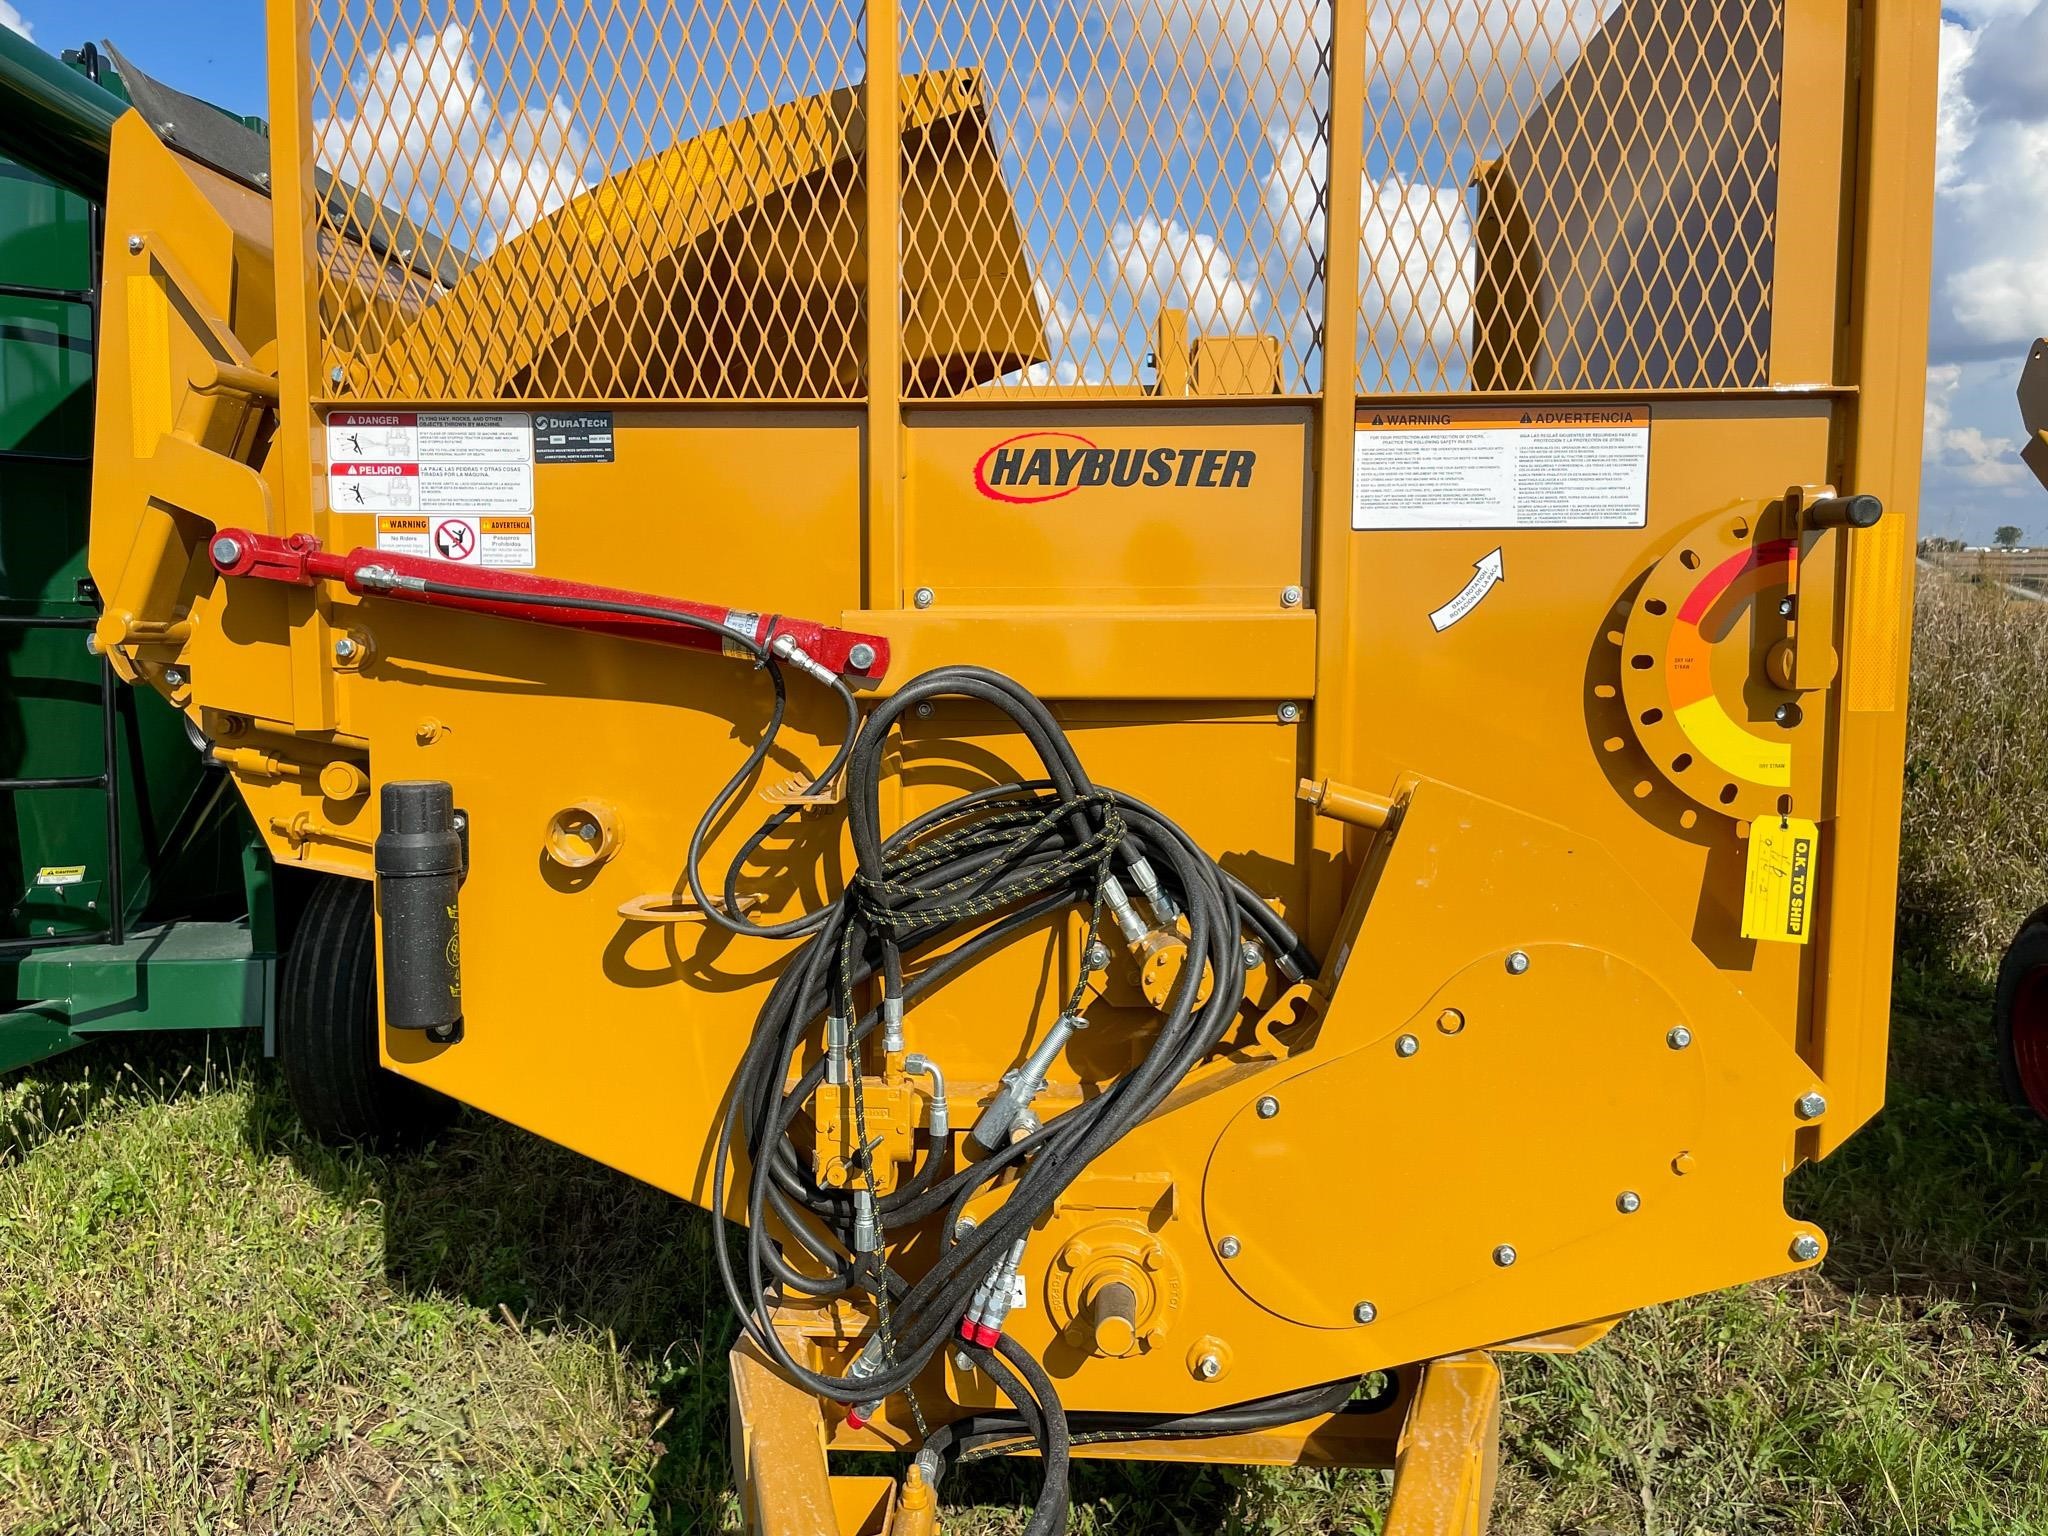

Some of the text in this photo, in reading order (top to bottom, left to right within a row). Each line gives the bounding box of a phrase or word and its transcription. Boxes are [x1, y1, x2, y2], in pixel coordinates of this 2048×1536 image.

[358, 416, 400, 425] DANGER
[1387, 412, 1633, 425] WARNING ADVERTENCIA
[359, 466, 403, 475] PELIGRO
[990, 448, 1257, 487] HAYBUSTER
[390, 520, 427, 528] WARNING
[492, 521, 530, 529] ADVERTENCIA
[1465, 570, 1488, 597] ROTATION
[1789, 842, 1808, 932] O.K. TO SHIP
